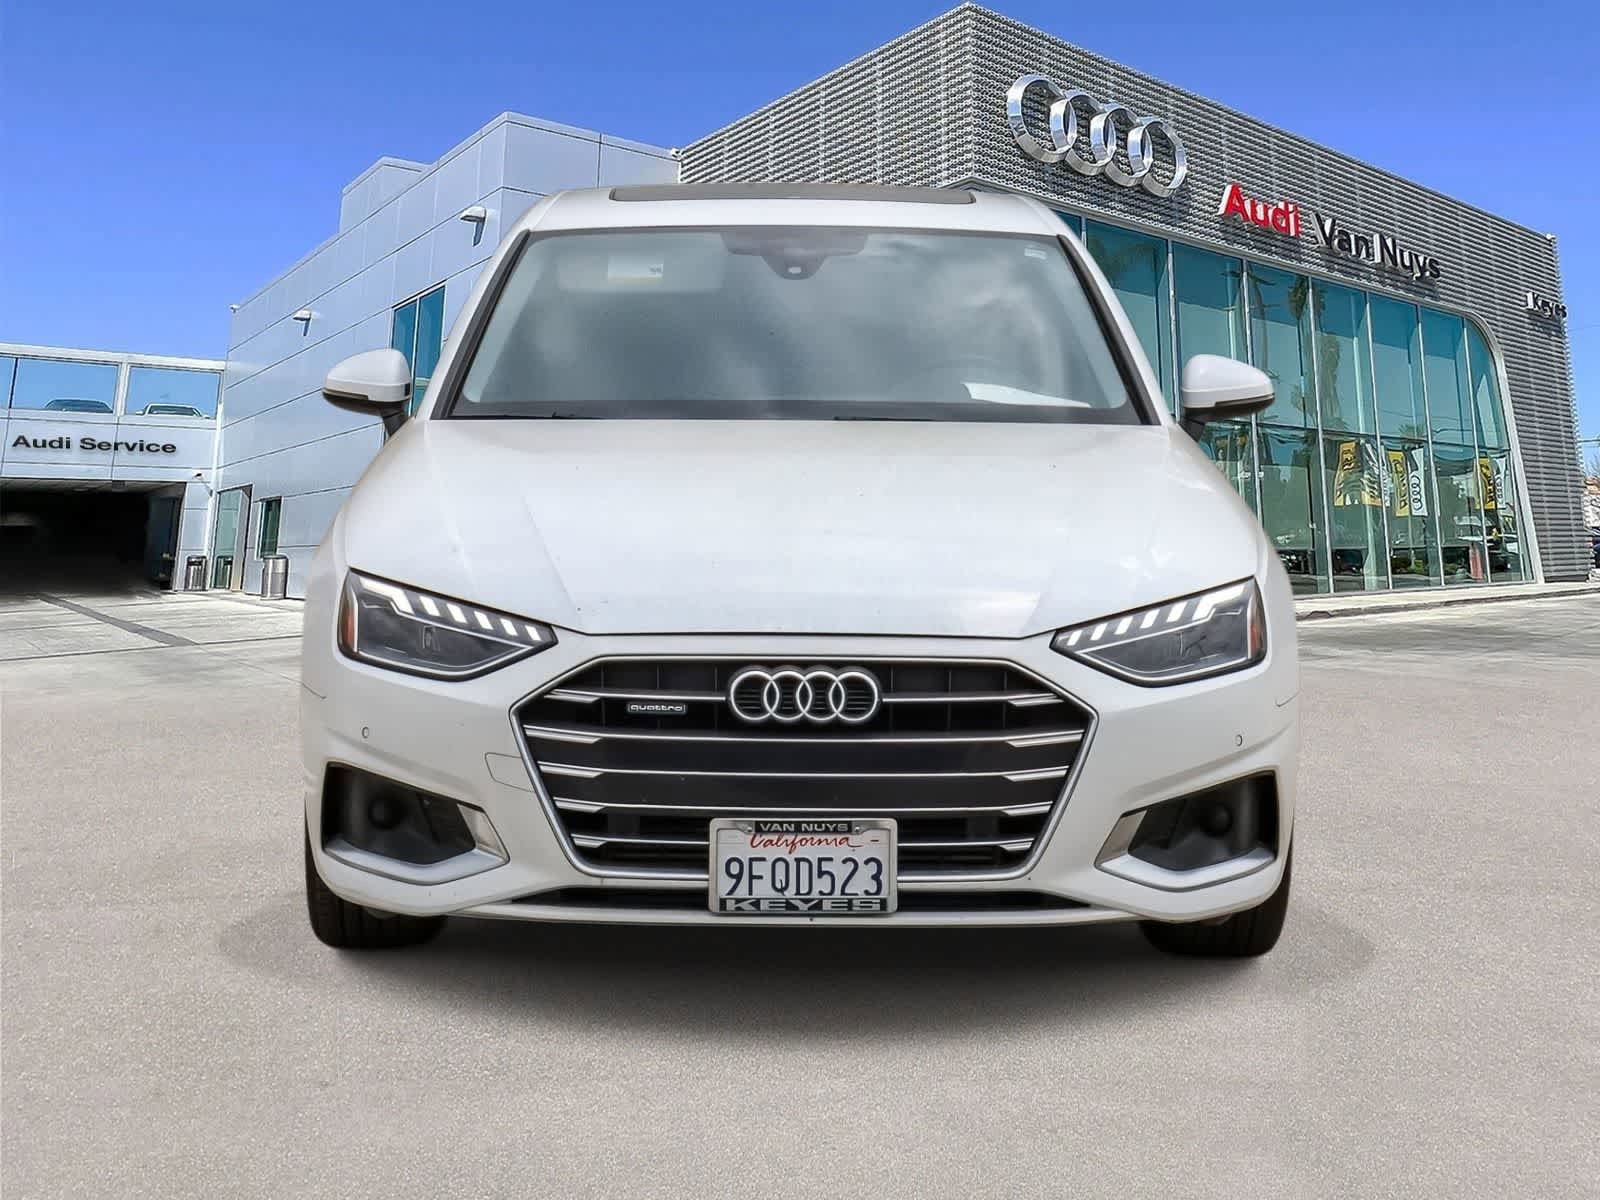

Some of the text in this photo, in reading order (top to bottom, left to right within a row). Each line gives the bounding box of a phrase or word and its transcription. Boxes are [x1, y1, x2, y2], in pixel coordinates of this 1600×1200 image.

[1218, 182, 1441, 281] Audi Van Nuys
[12, 435, 177, 454] Audi Service
[630, 704, 683, 712] quattro
[759, 822, 849, 832] VAN NUYS
[750, 832, 863, 855] California
[724, 856, 883, 897] 9FQD523
[726, 899, 881, 911] KEYES
